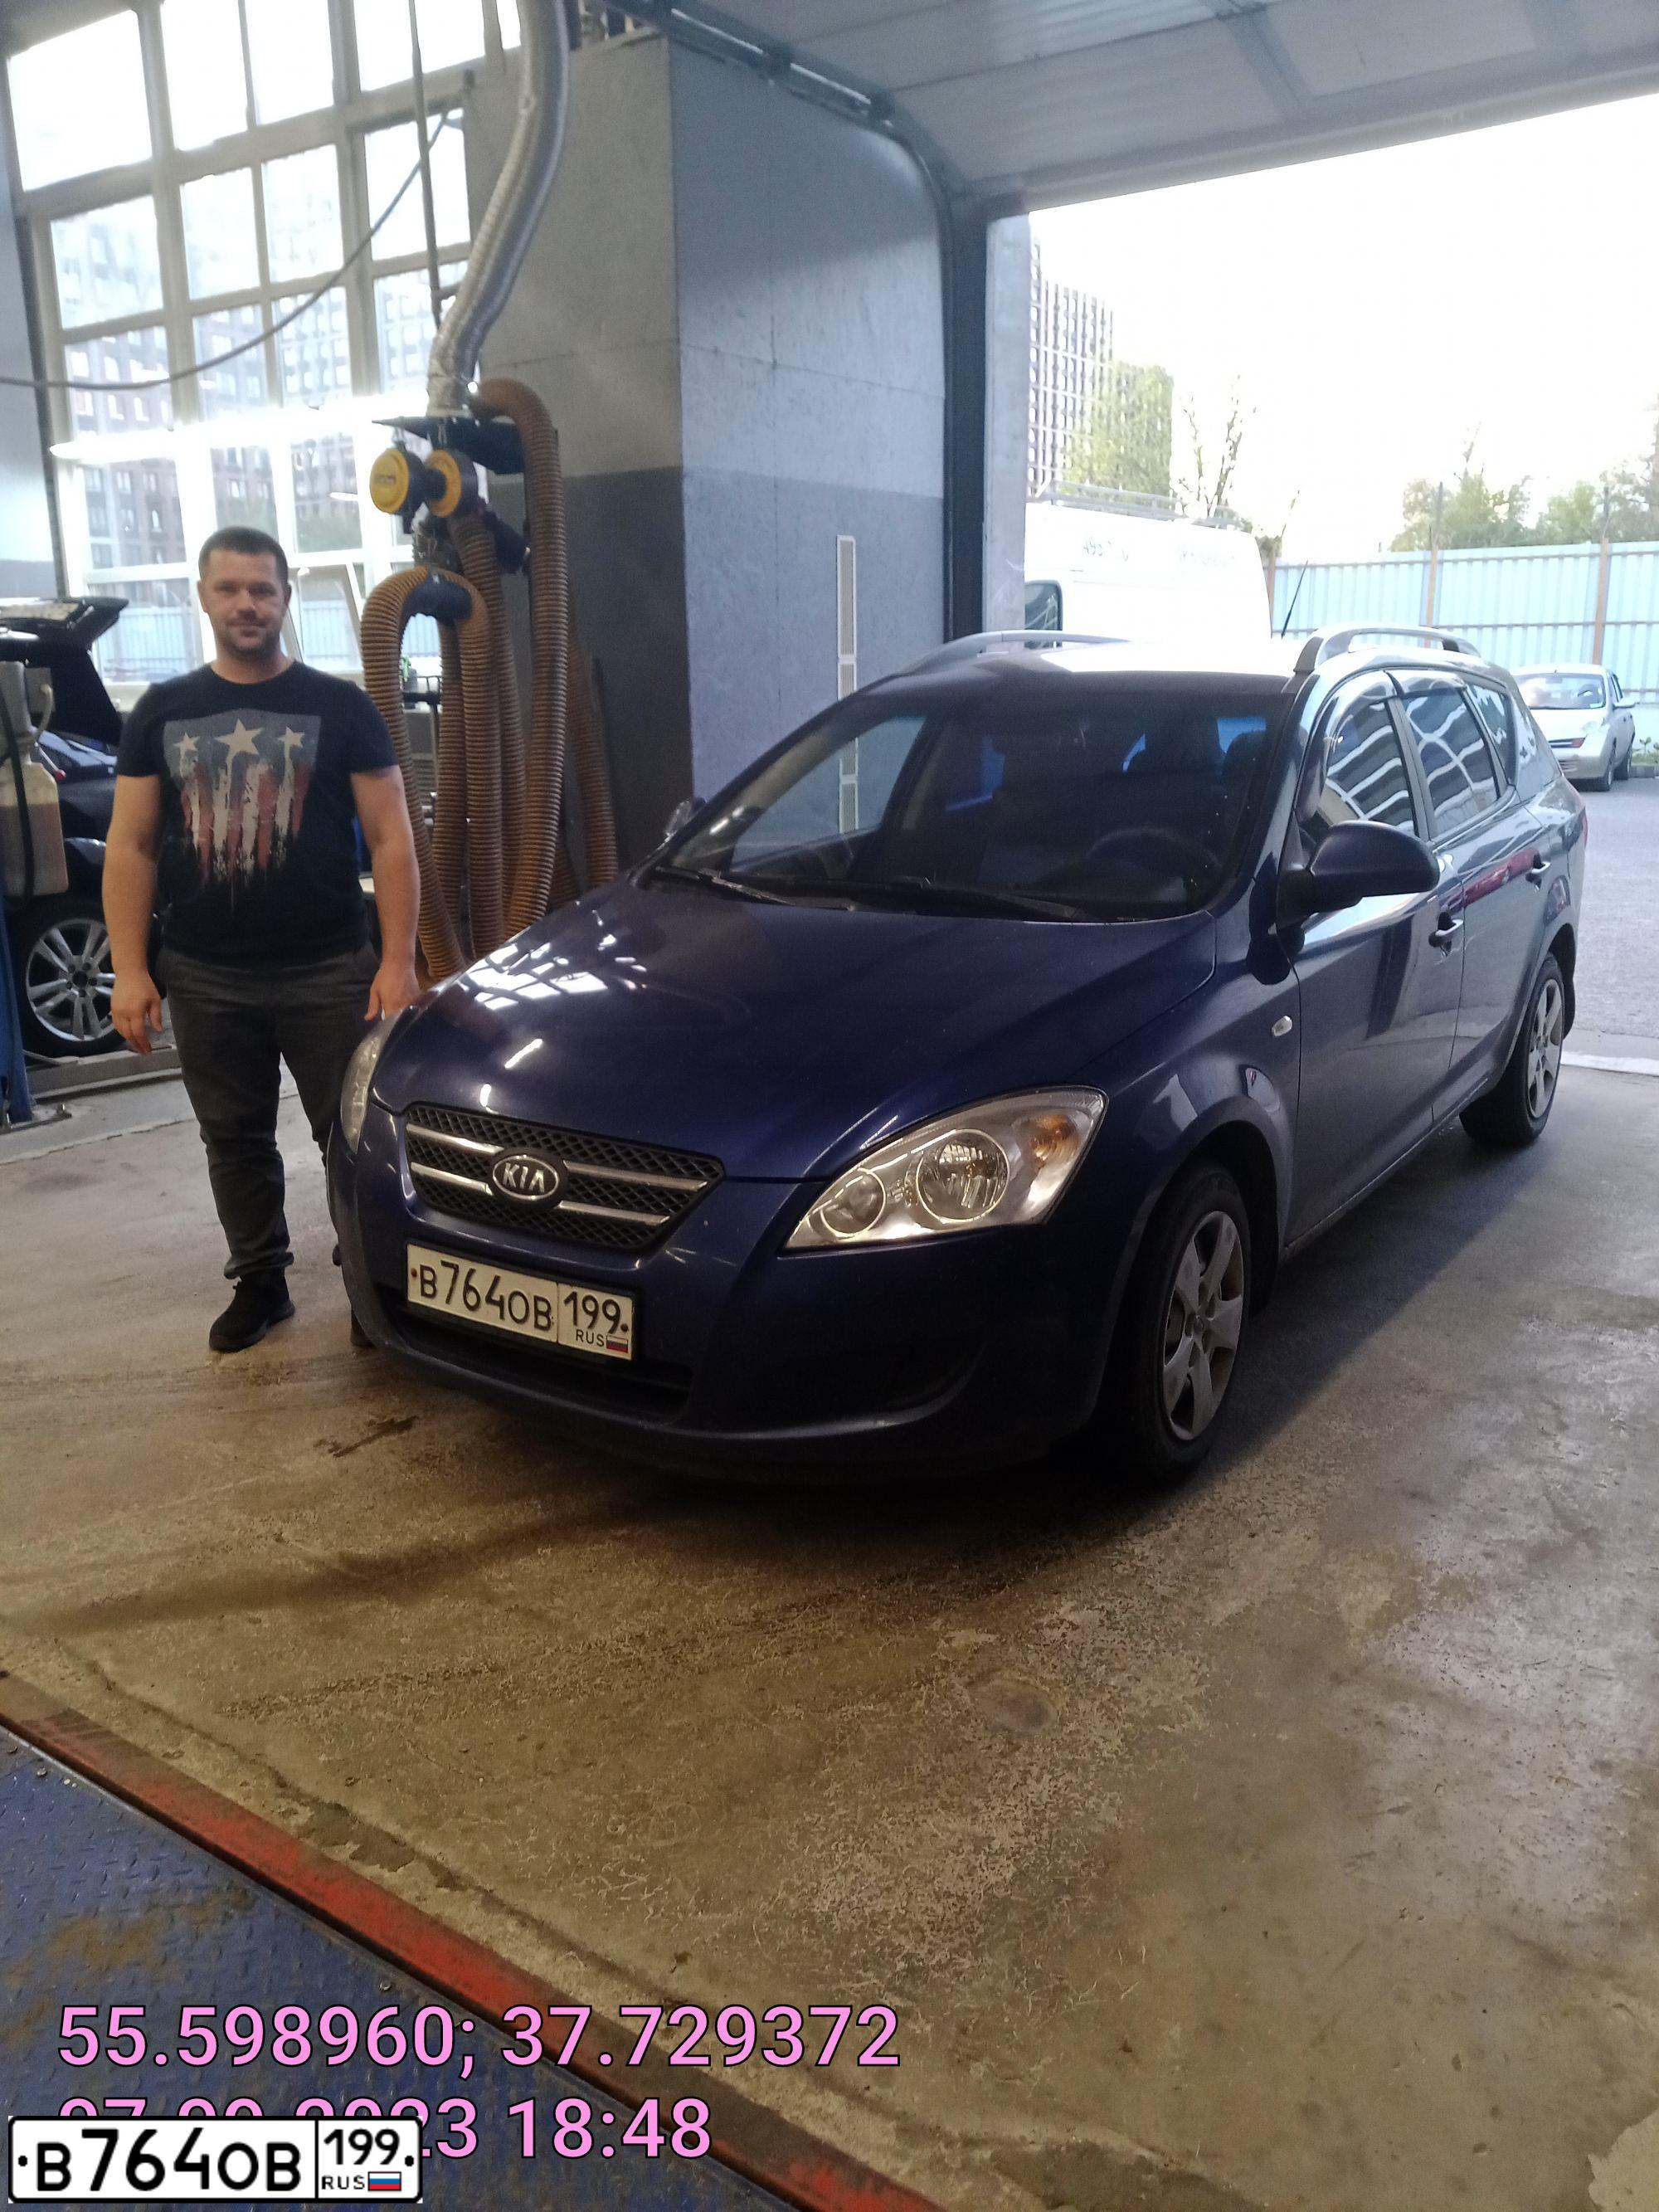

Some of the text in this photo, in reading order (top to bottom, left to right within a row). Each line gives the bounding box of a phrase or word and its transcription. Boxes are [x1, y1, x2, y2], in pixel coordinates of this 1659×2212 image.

[503, 1162, 546, 1193] KIA
[419, 1259, 621, 1335] В764ОВ 199
[575, 1328, 605, 1347] RUS
